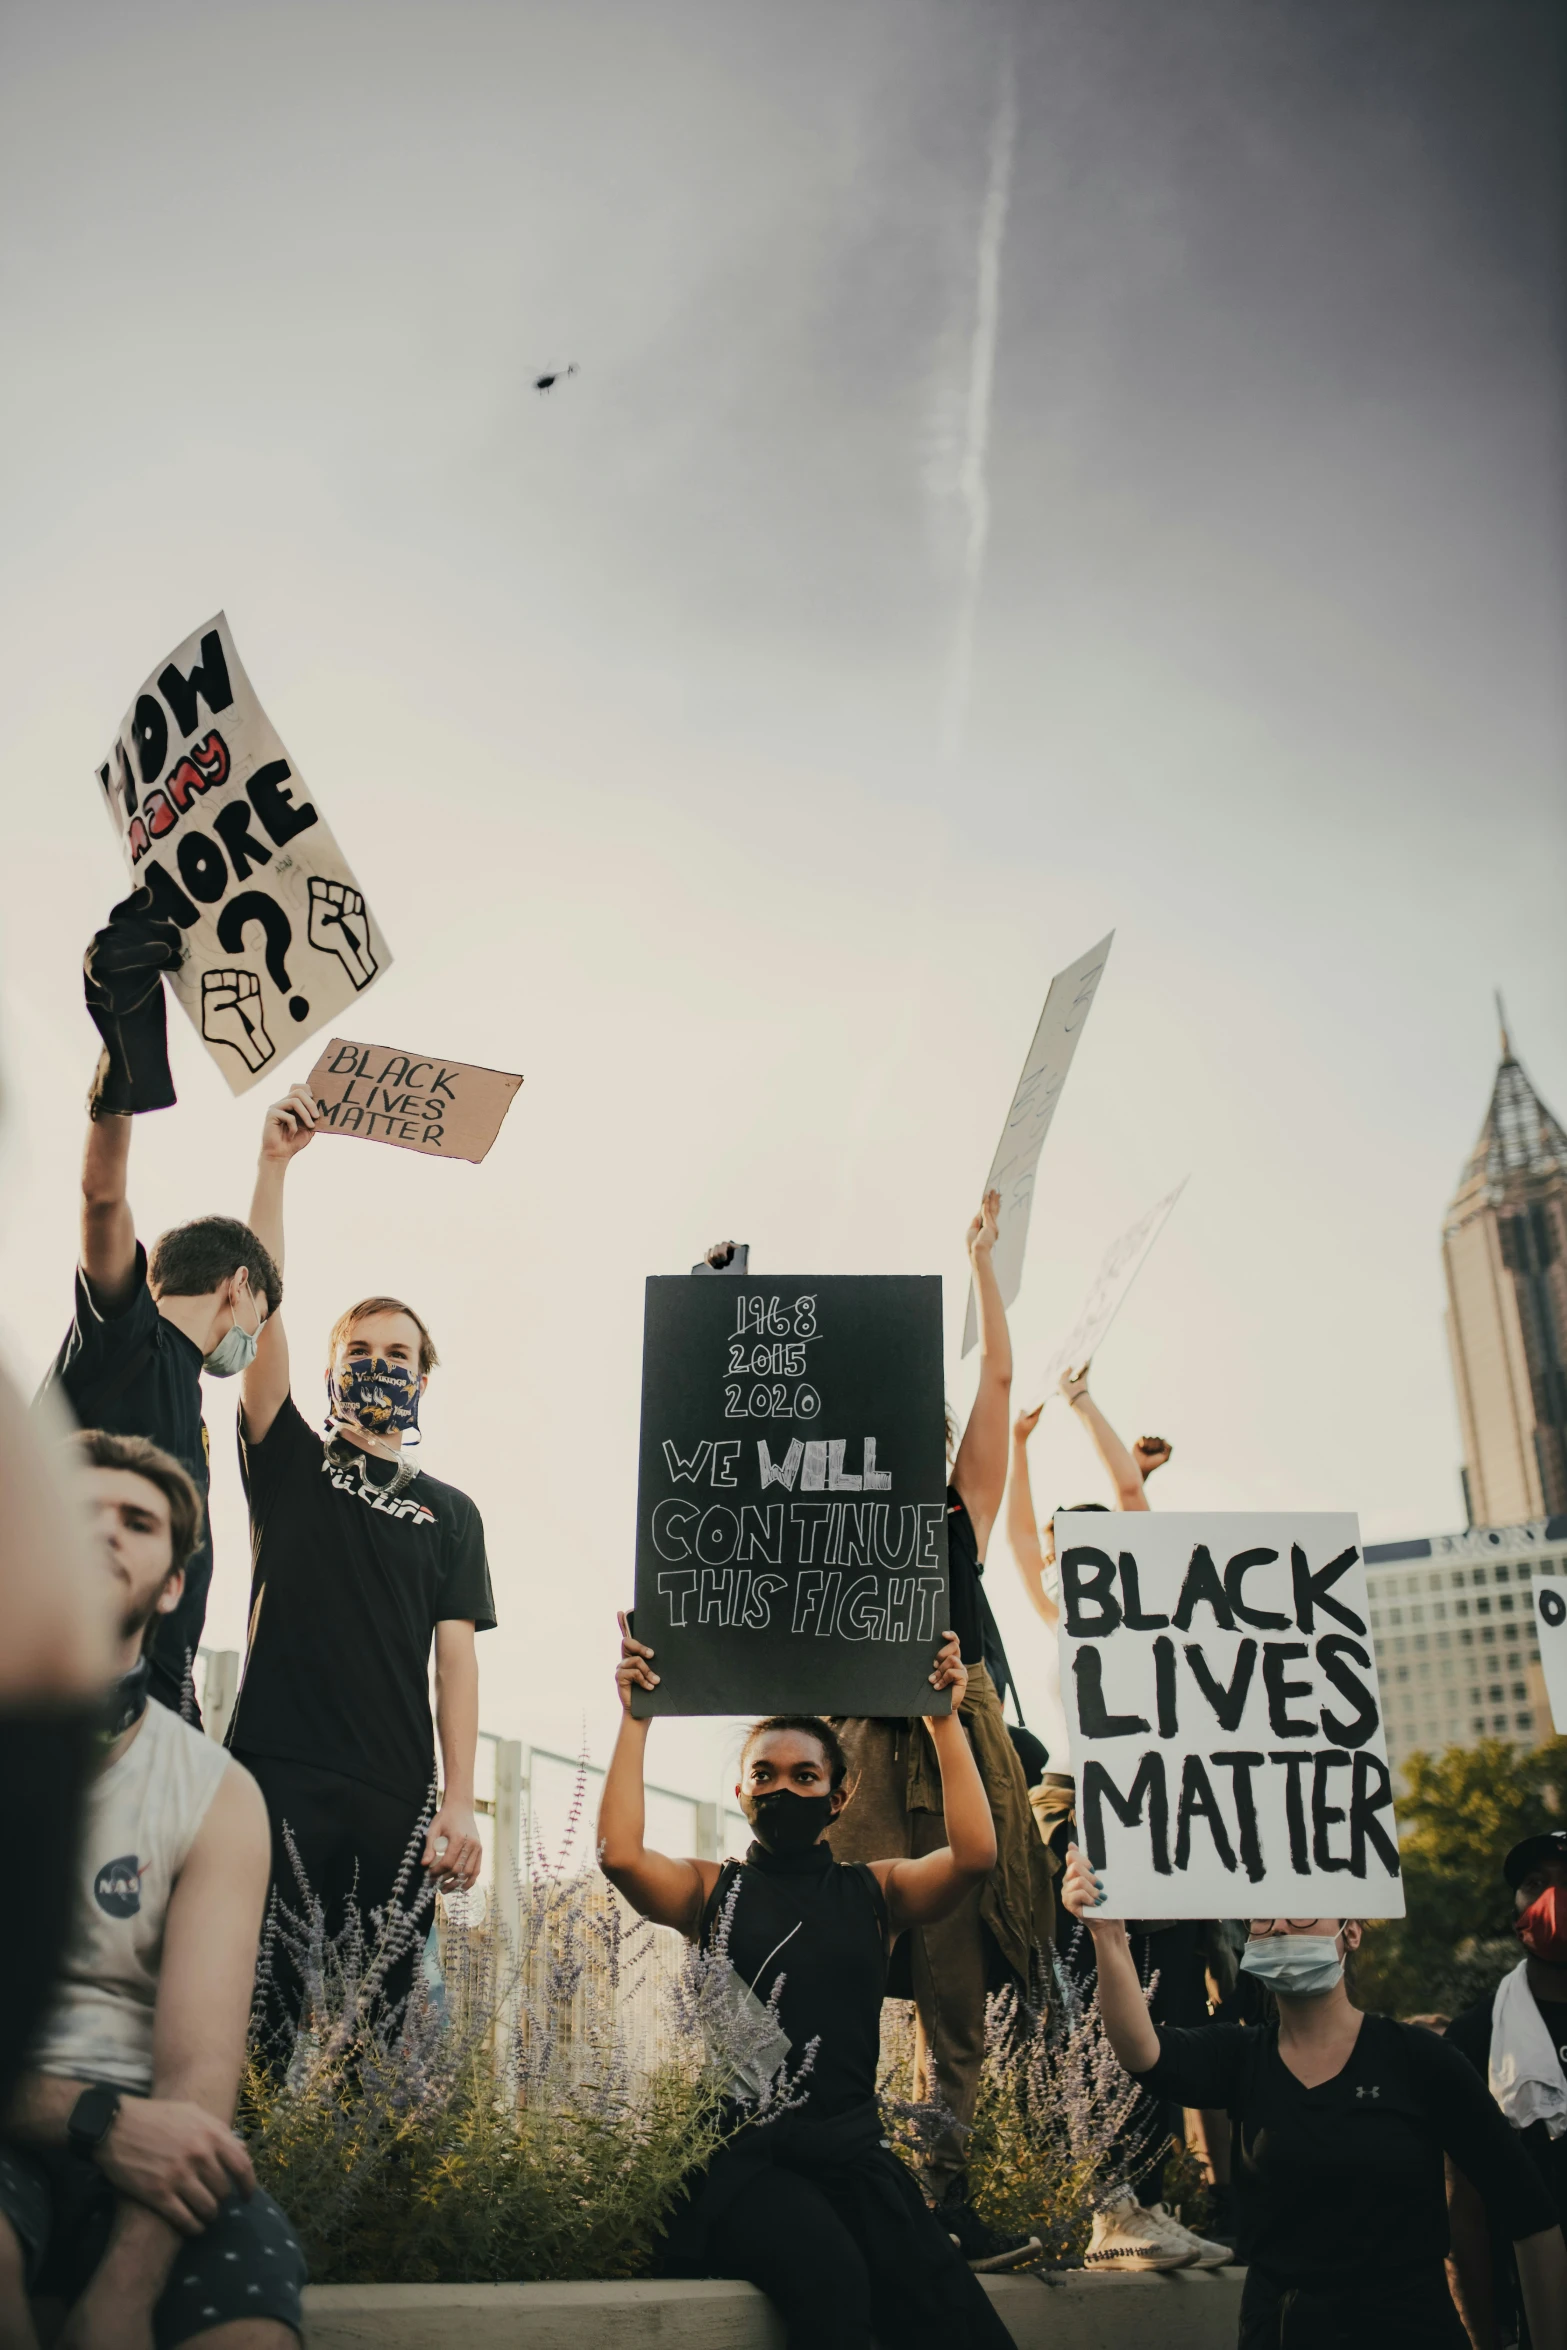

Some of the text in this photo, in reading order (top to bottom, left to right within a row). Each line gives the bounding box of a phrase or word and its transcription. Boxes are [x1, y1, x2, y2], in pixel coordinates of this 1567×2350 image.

[100, 629, 234, 818] HOW
[328, 1045, 460, 1100] BLACK
[341, 1079, 446, 1120] LIVES
[316, 1098, 445, 1147] MATTER
[736, 1296, 817, 1337] 1968
[728, 1342, 806, 1376] 2015
[725, 1383, 821, 1420] 2020
[662, 1437, 892, 1492] WE WILL
[651, 1497, 946, 1570] CONTINUE
[657, 1568, 945, 1643] THIS FIGHT
[1060, 1541, 1367, 1638] BLACK
[1071, 1633, 1379, 1750] LIVES
[1082, 1748, 1401, 1884] MATTER
[99, 1878, 139, 1895] NAS
